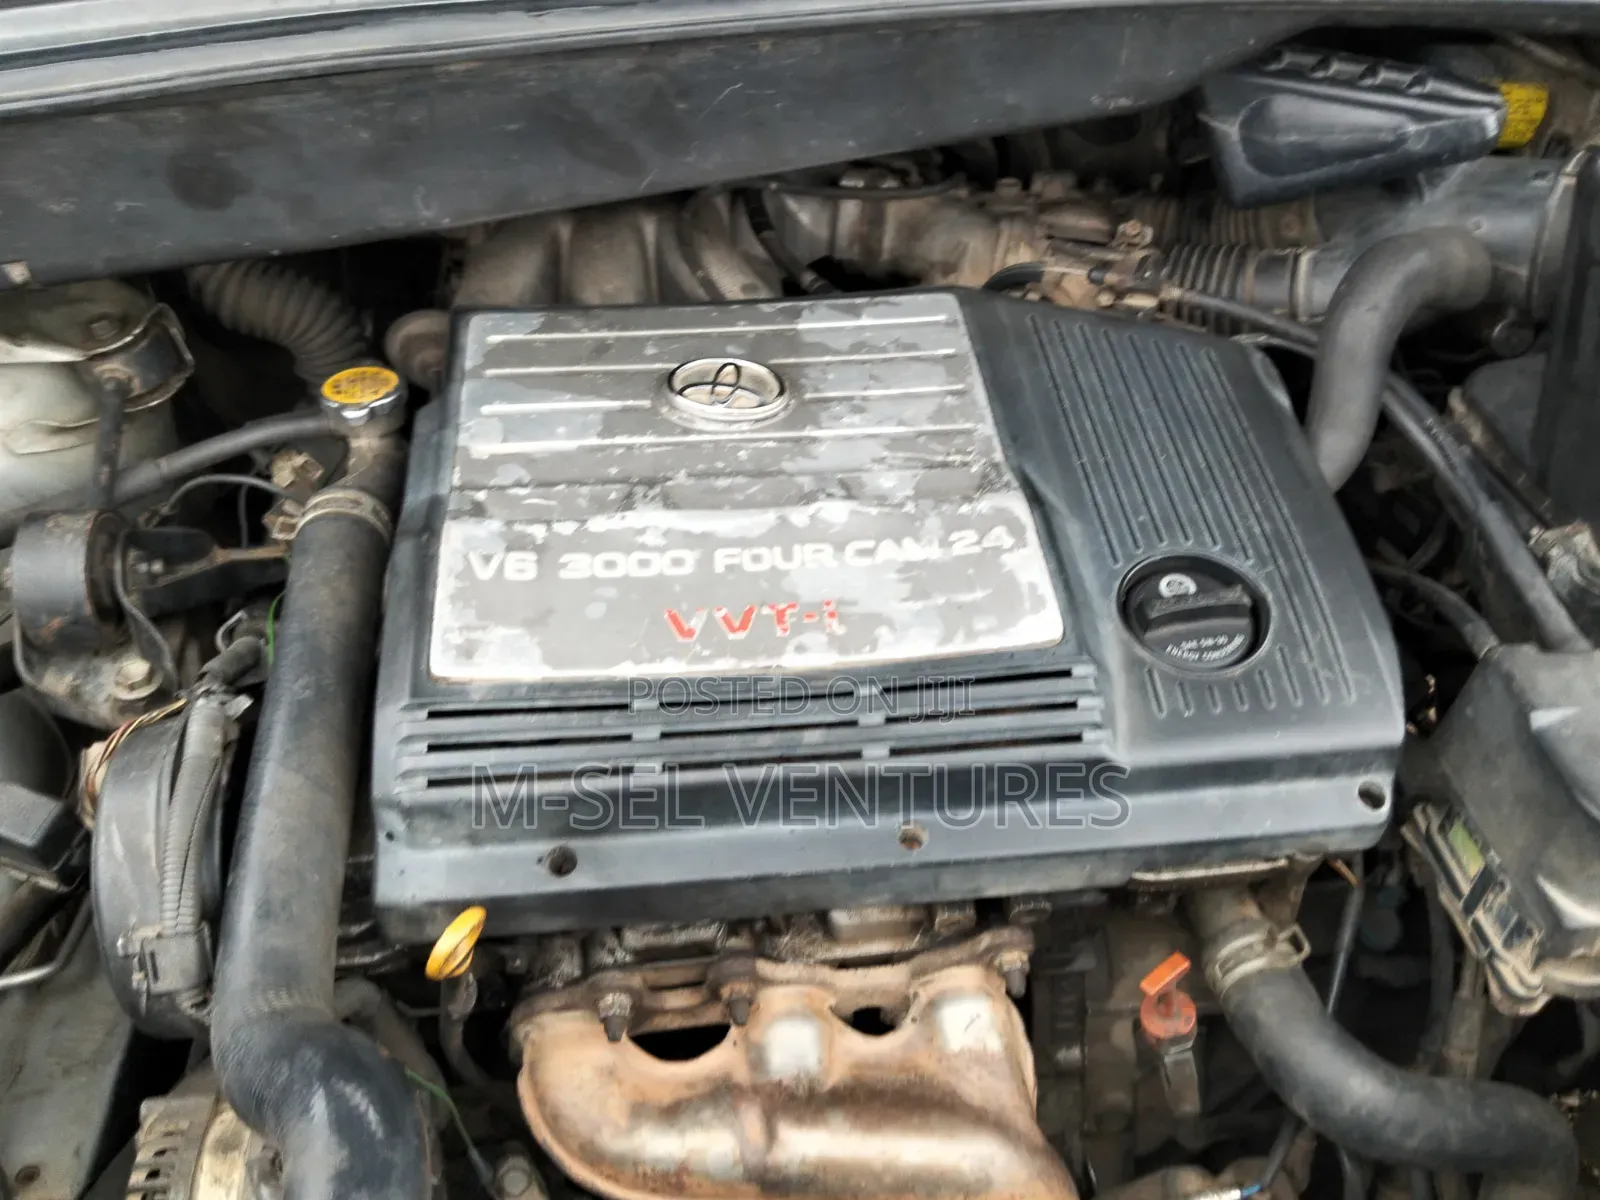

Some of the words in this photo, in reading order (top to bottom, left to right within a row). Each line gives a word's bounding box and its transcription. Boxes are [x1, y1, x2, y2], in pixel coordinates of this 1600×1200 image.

[467, 551, 538, 581] V6
[557, 549, 696, 579] 3000
[713, 542, 839, 573] FOUR
[948, 525, 1015, 556] 24
[663, 600, 841, 641] VVT-i
